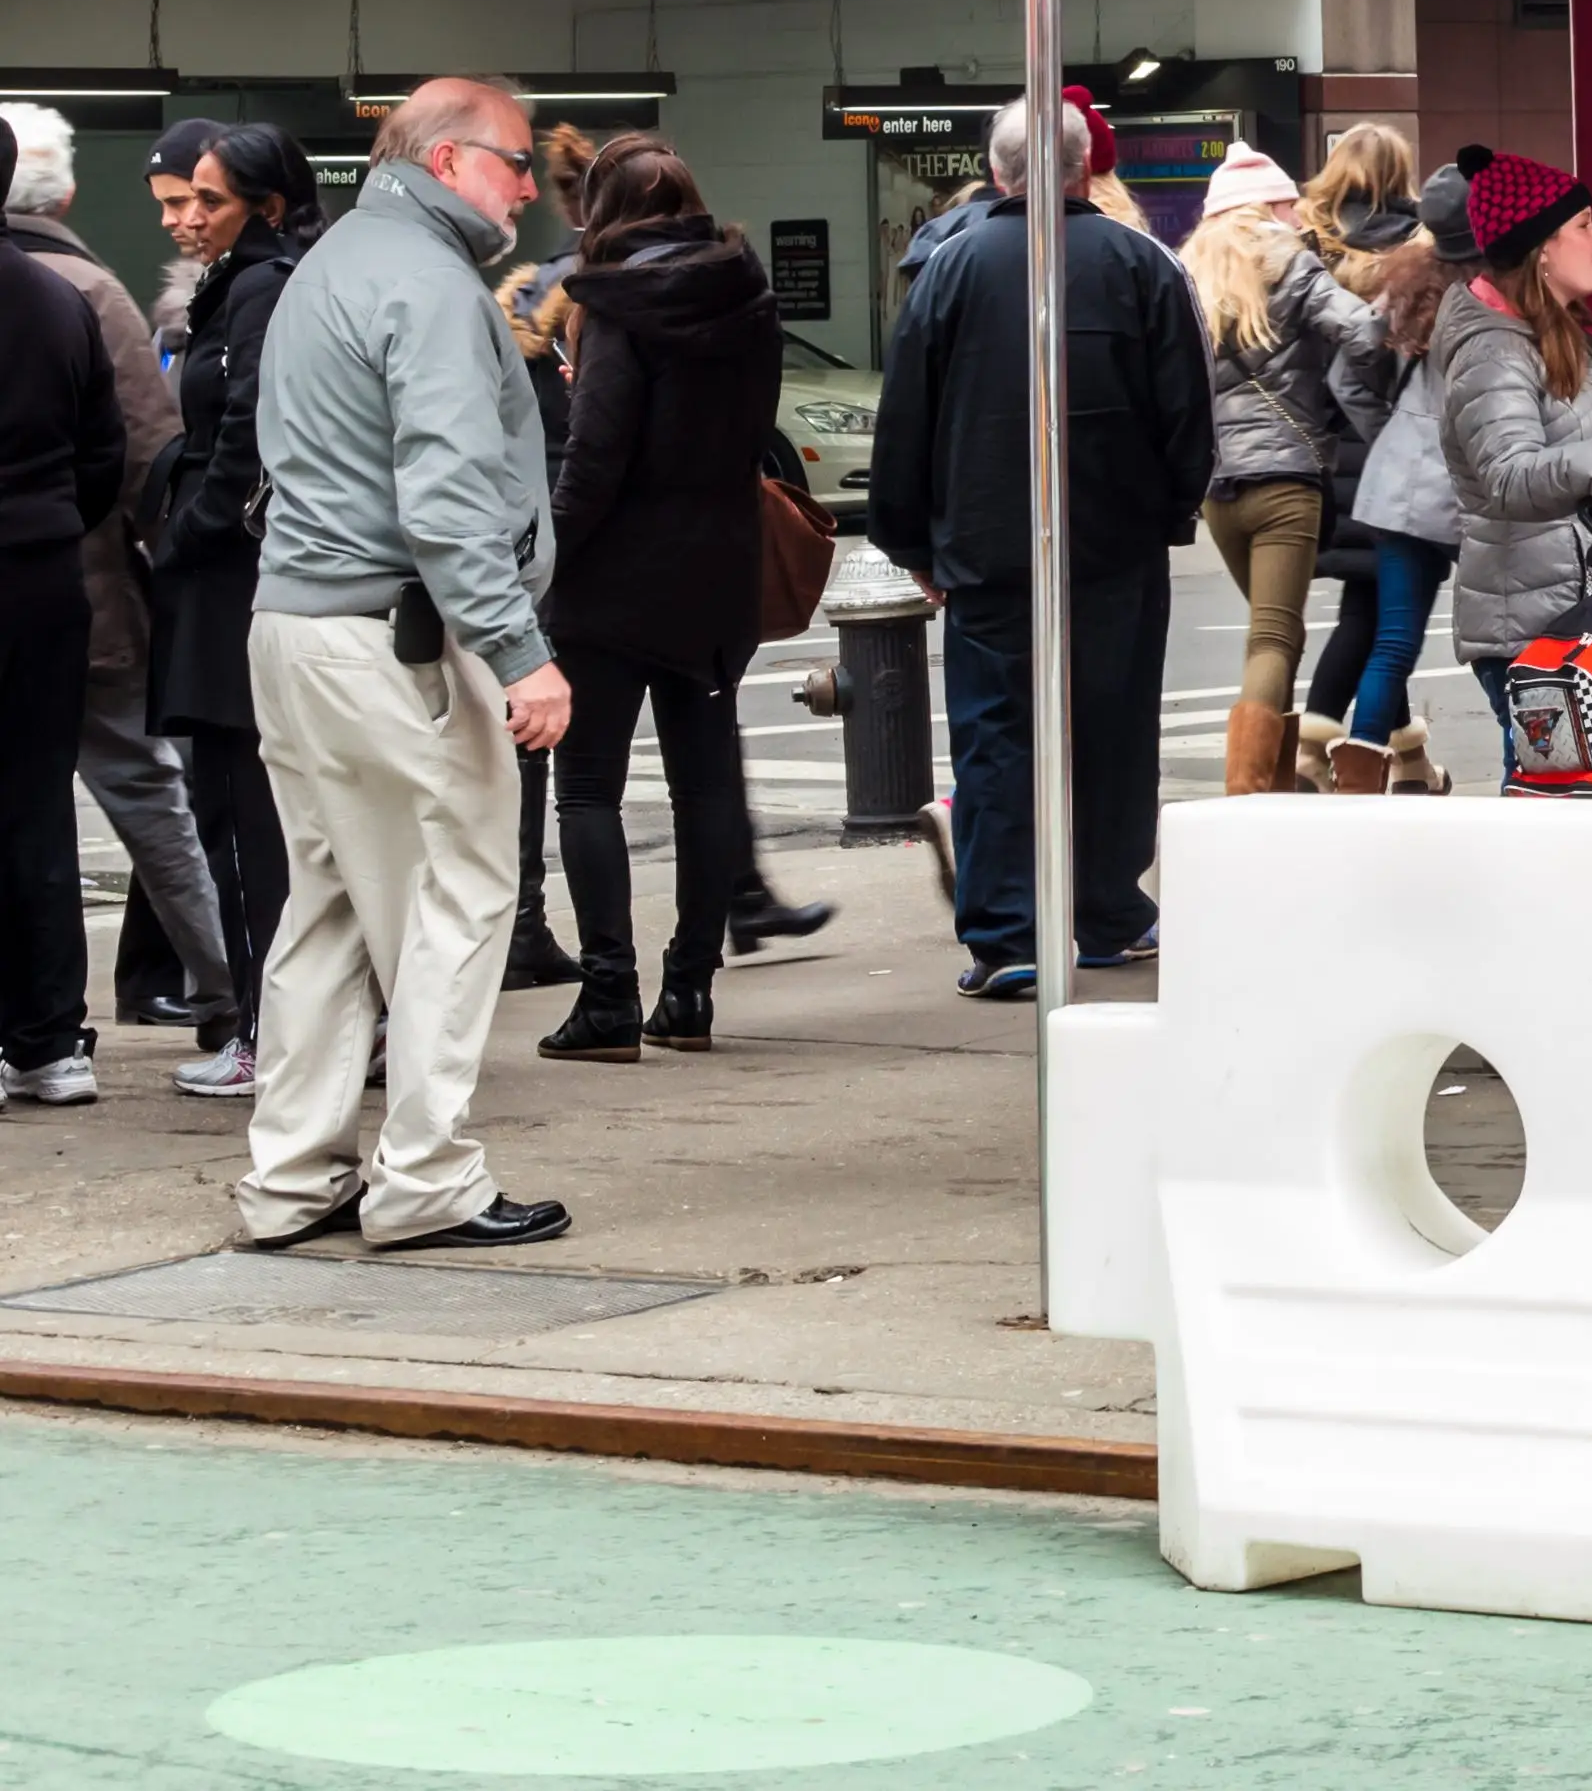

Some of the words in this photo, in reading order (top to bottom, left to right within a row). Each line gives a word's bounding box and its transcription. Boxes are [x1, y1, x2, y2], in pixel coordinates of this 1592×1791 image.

[1274, 58, 1295, 71] 190
[356, 101, 390, 118] icon
[882, 118, 918, 134] enter
[922, 115, 952, 133] here
[316, 168, 357, 185] ahead
[775, 233, 818, 249] warning
